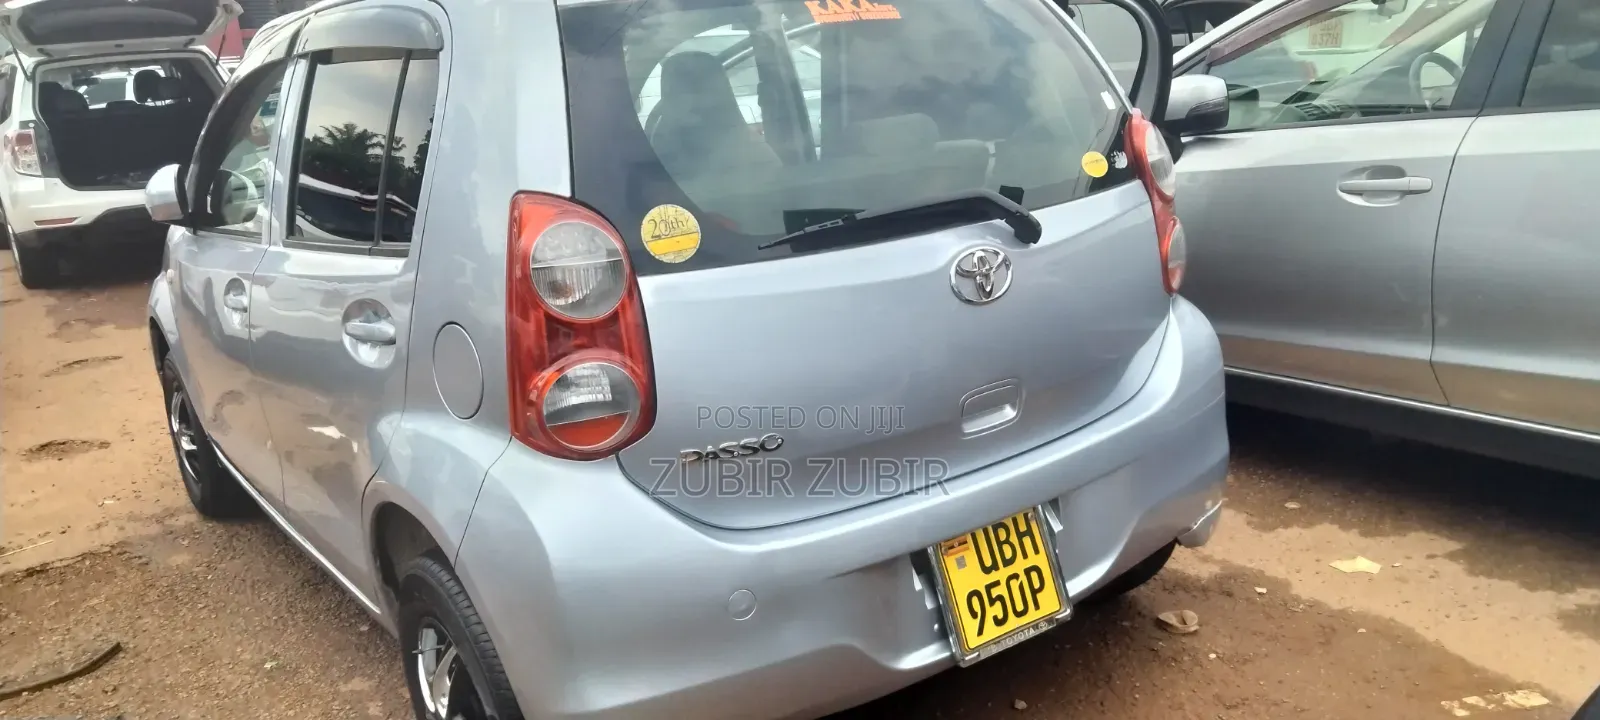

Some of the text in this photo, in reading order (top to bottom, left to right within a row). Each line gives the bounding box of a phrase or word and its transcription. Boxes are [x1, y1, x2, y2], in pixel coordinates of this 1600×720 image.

[804, 0, 877, 15] KAKA
[679, 432, 785, 463] PASSO
[970, 511, 1041, 576] UBH
[965, 564, 1046, 638] 950P
[1001, 626, 1036, 648] TOYOTA
